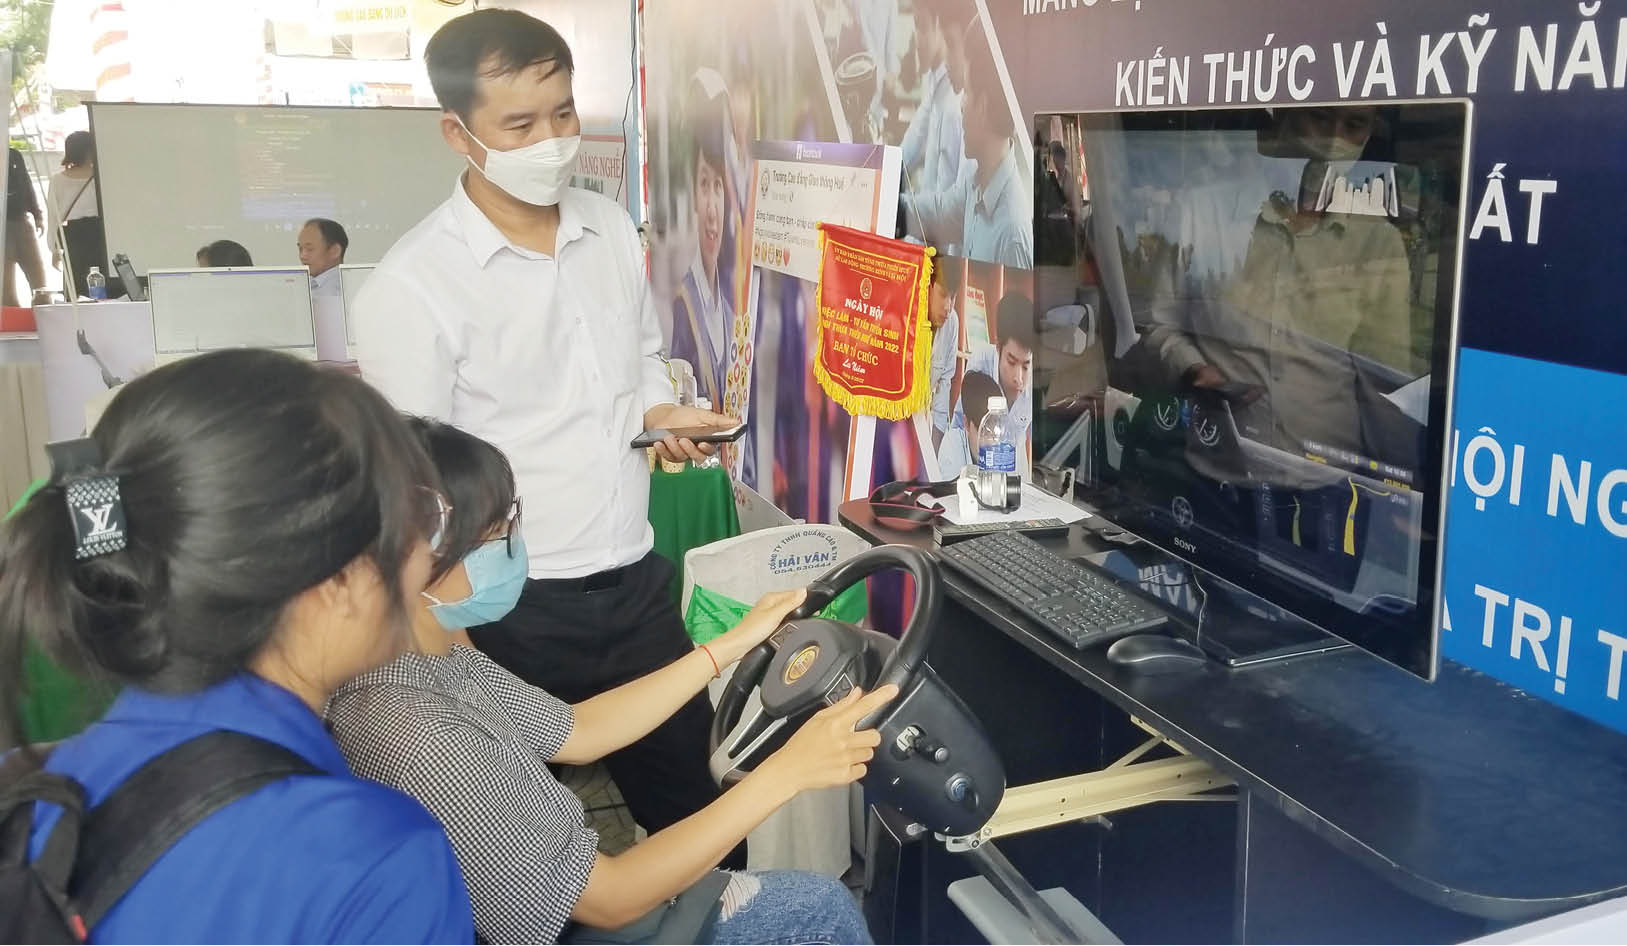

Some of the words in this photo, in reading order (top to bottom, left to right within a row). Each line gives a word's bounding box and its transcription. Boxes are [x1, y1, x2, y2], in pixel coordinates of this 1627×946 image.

[1115, 46, 1190, 106] KIẾN
[1203, 33, 1316, 103] THỨC
[1333, 22, 1397, 98] VÀ
[1416, 13, 1498, 96] KỸ
[845, 298, 868, 314] NGÀY
[869, 305, 883, 320] HỘI
[883, 329, 899, 341] SINH
[884, 342, 899, 354] 2022
[857, 350, 878, 366] CHỨC
[773, 544, 782, 553] TY
[1174, 537, 1197, 553] SONY
[778, 554, 800, 568] HẢI
[804, 552, 830, 564] VÂN
[1474, 583, 1572, 695] TRỊ
